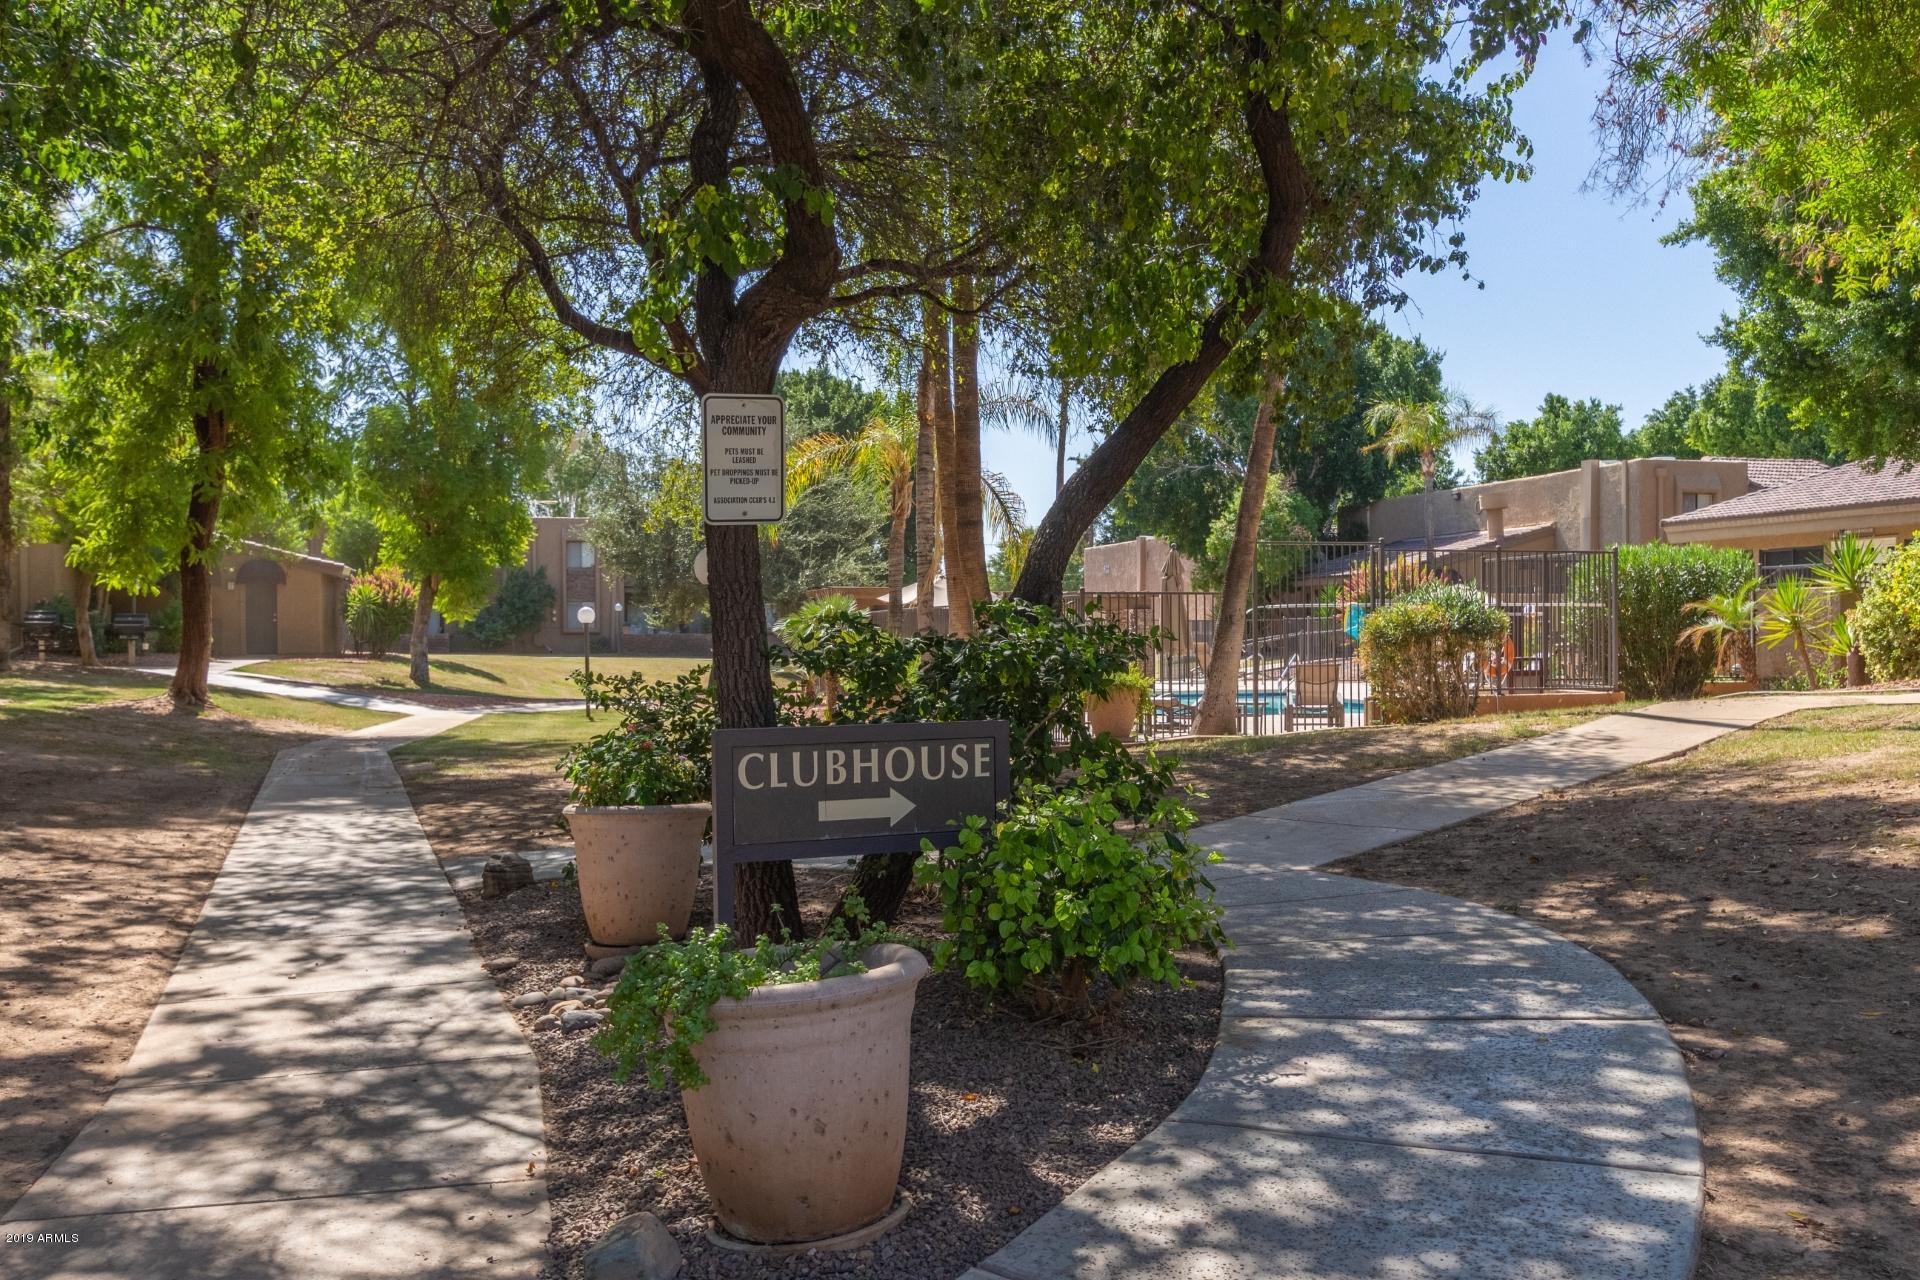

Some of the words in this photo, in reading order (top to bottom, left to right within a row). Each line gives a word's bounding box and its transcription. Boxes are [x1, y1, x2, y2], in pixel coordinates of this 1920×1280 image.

[711, 415, 755, 424] APPRECIATE
[758, 416, 777, 424] YOUR
[722, 426, 767, 436] COMMUNITY
[738, 743, 990, 790] CLUBHOUSE
